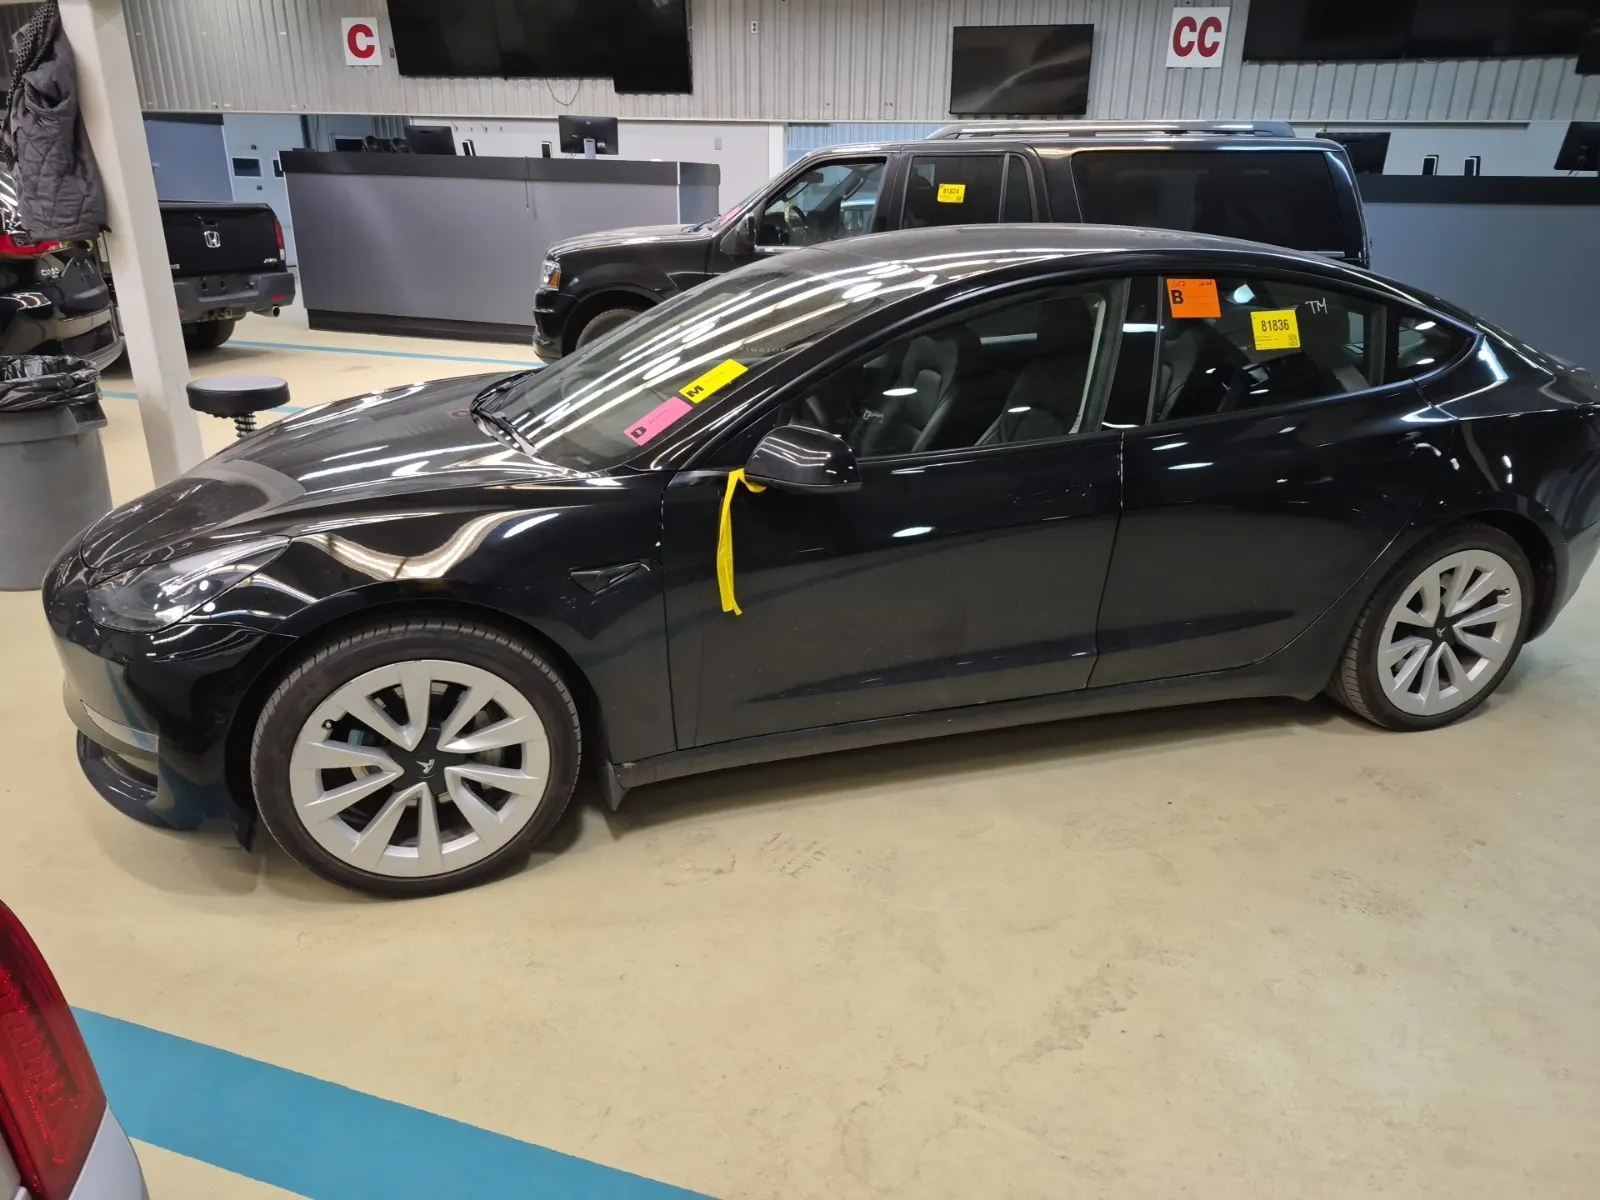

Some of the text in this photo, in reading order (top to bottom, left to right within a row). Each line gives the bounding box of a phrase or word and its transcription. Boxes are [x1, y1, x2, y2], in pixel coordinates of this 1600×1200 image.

[347, 23, 376, 59] C
[1172, 16, 1222, 58] CC
[1170, 289, 1184, 305] B
[1304, 297, 1329, 315] TM
[1260, 318, 1290, 332] 81836
[685, 384, 705, 398] M
[630, 426, 648, 439] D
